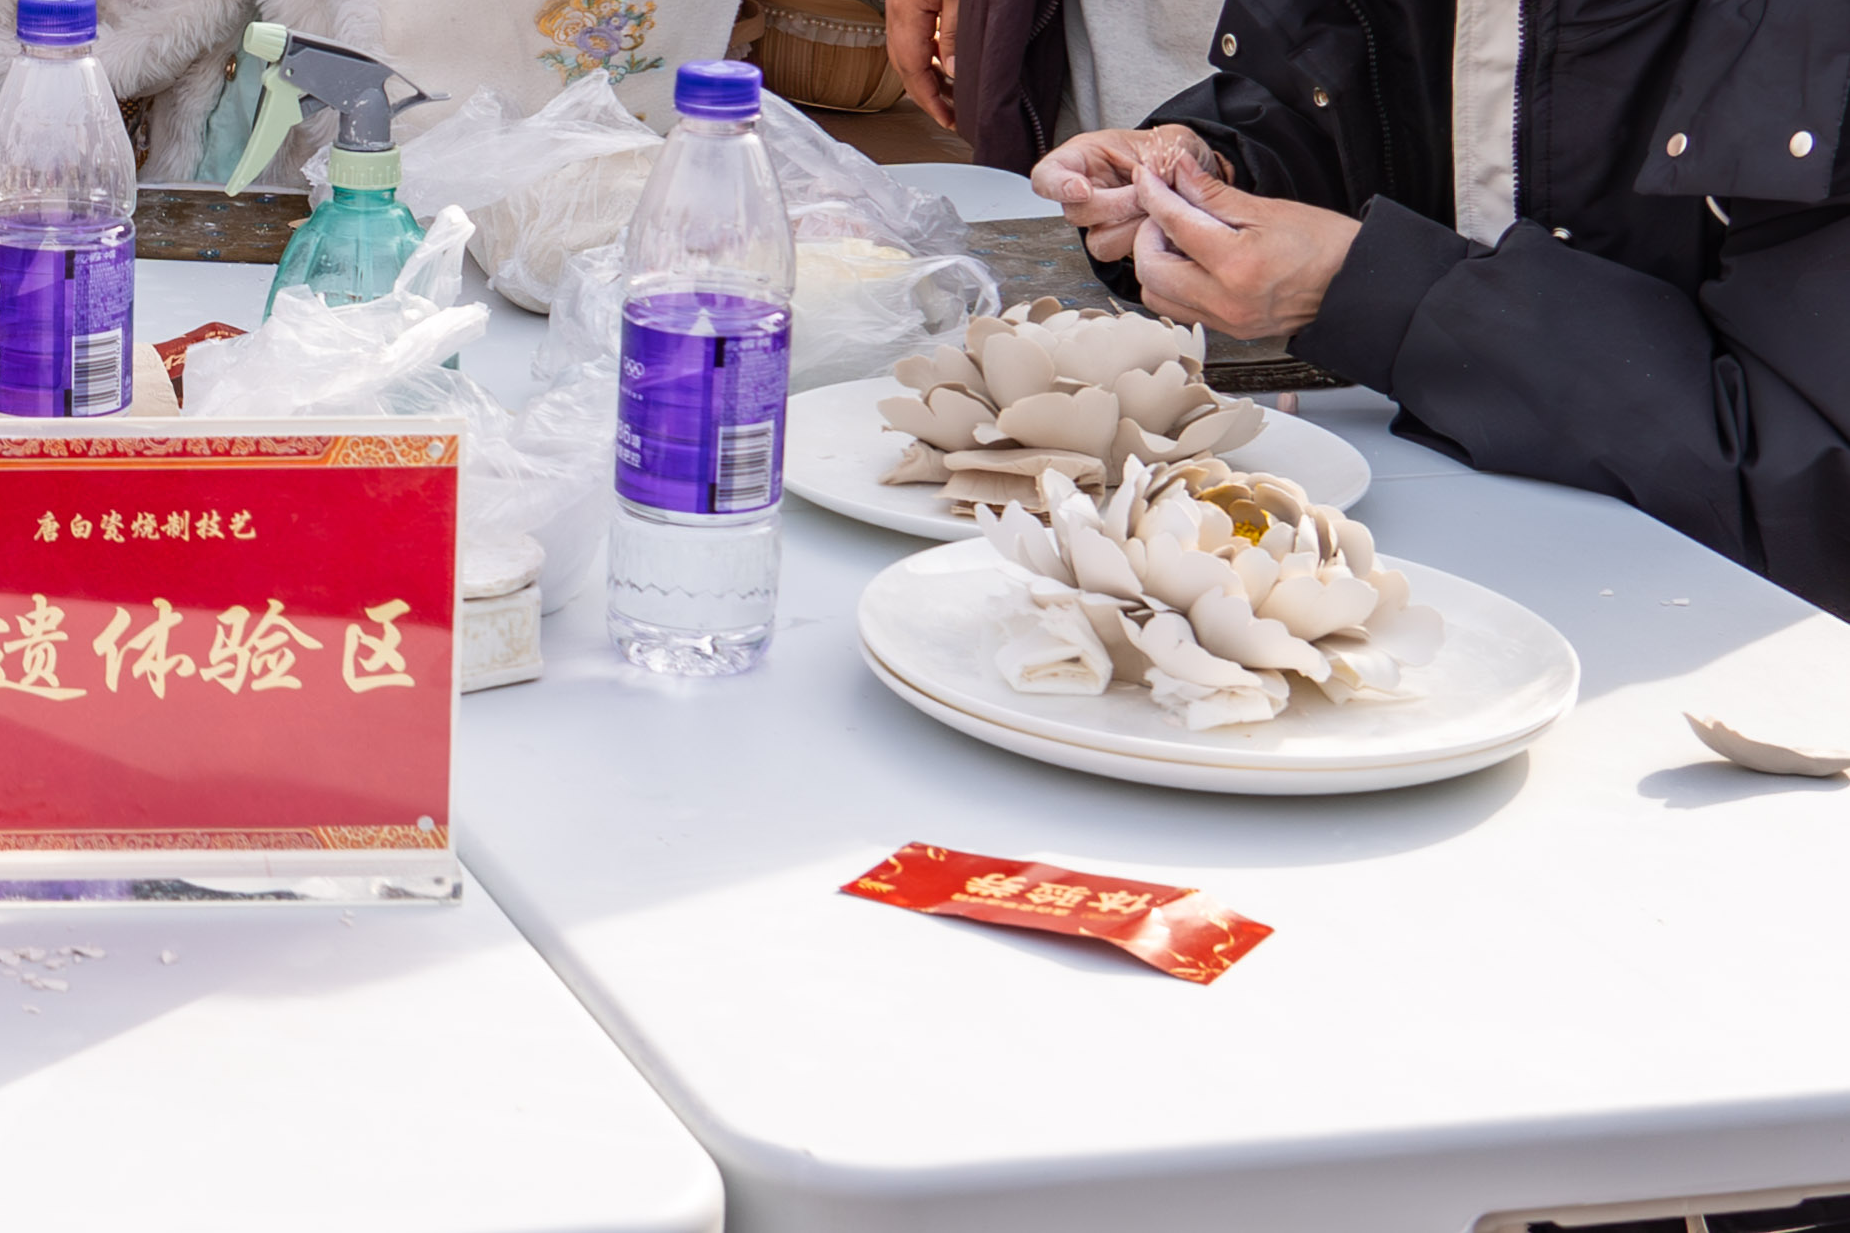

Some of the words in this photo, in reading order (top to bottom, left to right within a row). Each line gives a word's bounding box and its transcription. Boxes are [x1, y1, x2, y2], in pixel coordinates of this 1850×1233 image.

[33, 509, 257, 544] 唐白瓷烧制技艺
[964, 872, 1154, 915] 体验券
